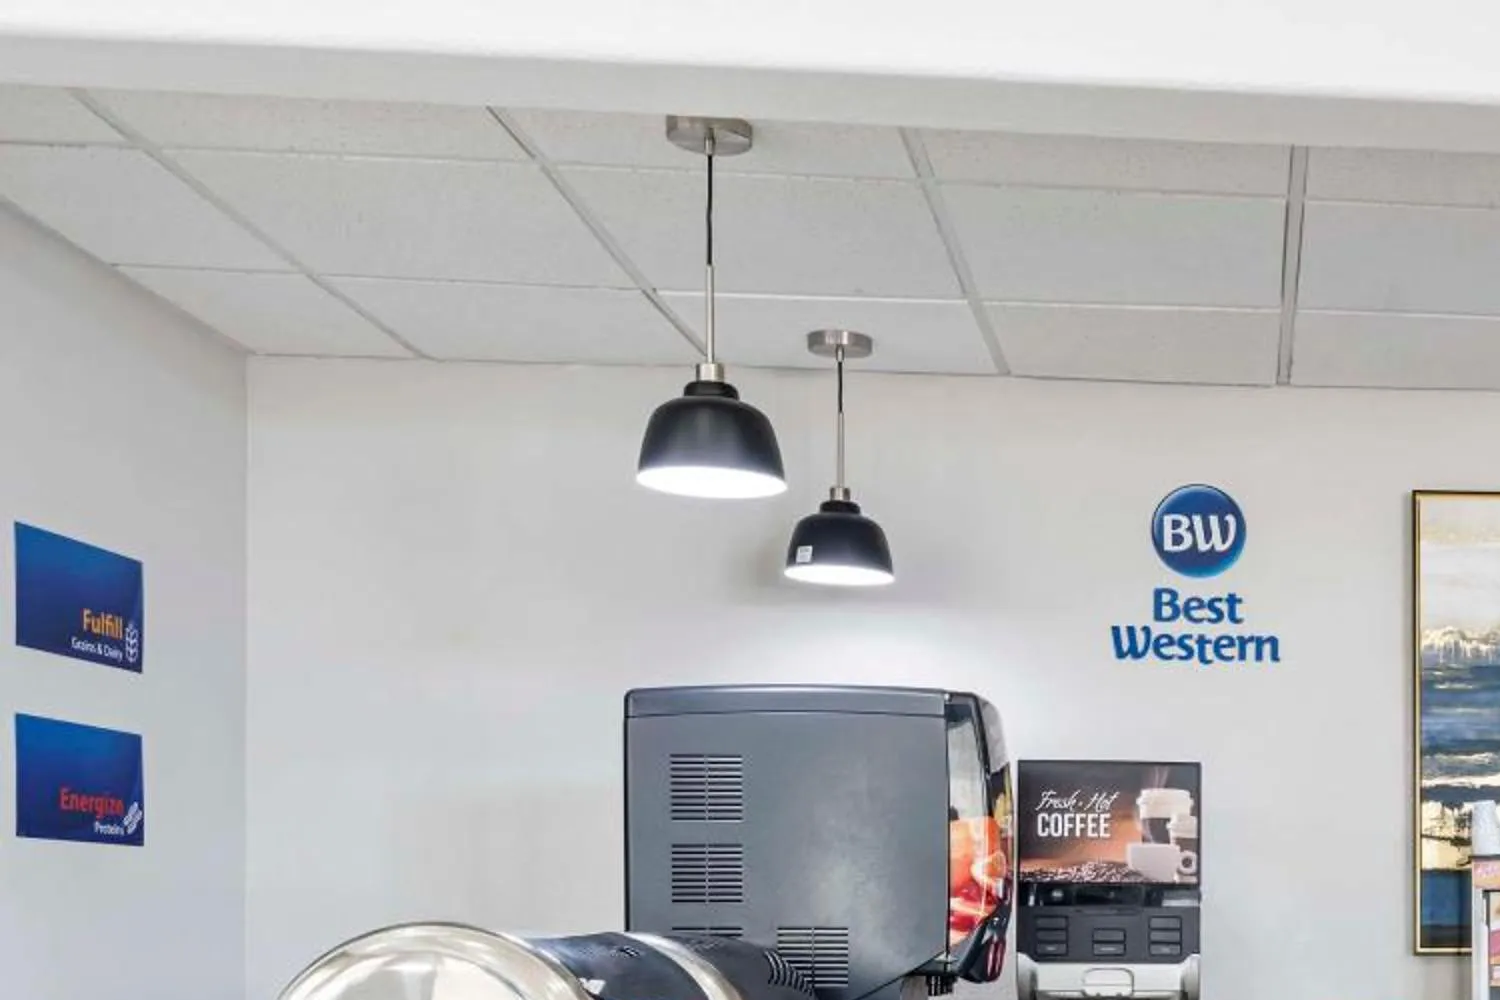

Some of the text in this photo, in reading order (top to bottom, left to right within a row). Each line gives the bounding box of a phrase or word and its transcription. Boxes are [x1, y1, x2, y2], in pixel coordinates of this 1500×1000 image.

[1161, 514, 1237, 554] BW
[1152, 587, 1244, 625] Best
[81, 608, 123, 640] Fulfill
[70, 636, 96, 653] Grains
[104, 644, 123, 663] Dairy
[1111, 625, 1281, 665] Western
[59, 787, 124, 819] Energize
[1035, 789, 1121, 812] Fresh Hot
[94, 820, 125, 836] Proteins
[1037, 812, 1111, 838] COFFEE
